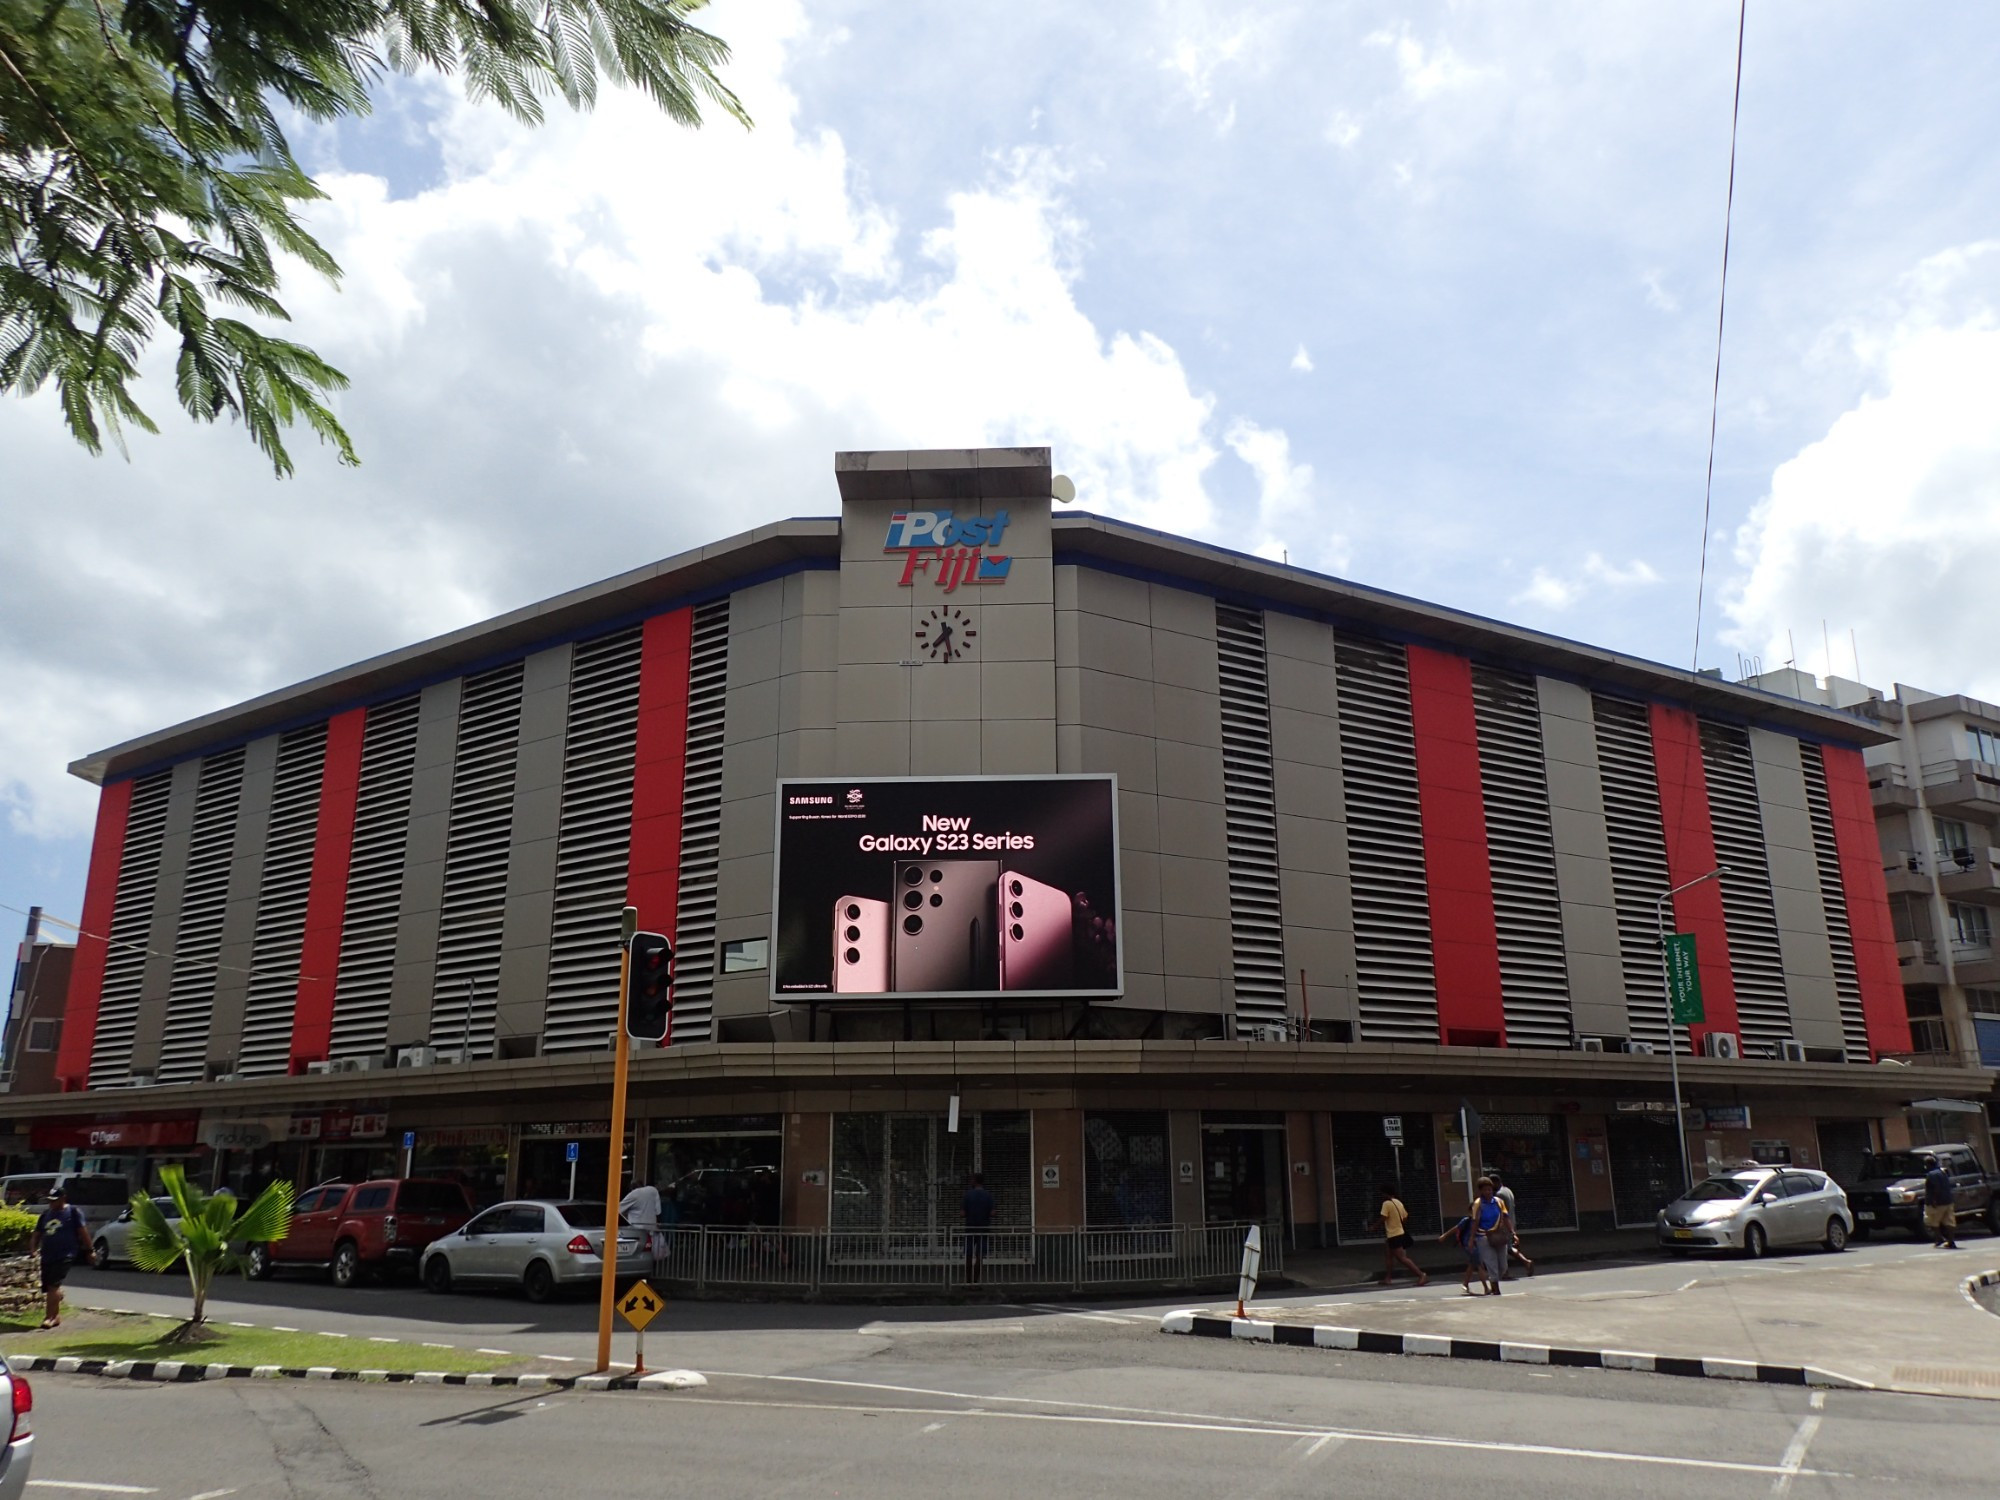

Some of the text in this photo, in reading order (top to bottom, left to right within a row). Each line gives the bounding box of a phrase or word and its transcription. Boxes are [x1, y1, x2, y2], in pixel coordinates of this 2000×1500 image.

[892, 547, 986, 593] Fiji
[789, 796, 833, 805] SAMSUNG
[922, 814, 971, 832] New
[859, 831, 1034, 855] Galaxy S23 Series
[1682, 951, 1693, 992] YOUR WAY
[1678, 982, 1686, 1003] YOUR
